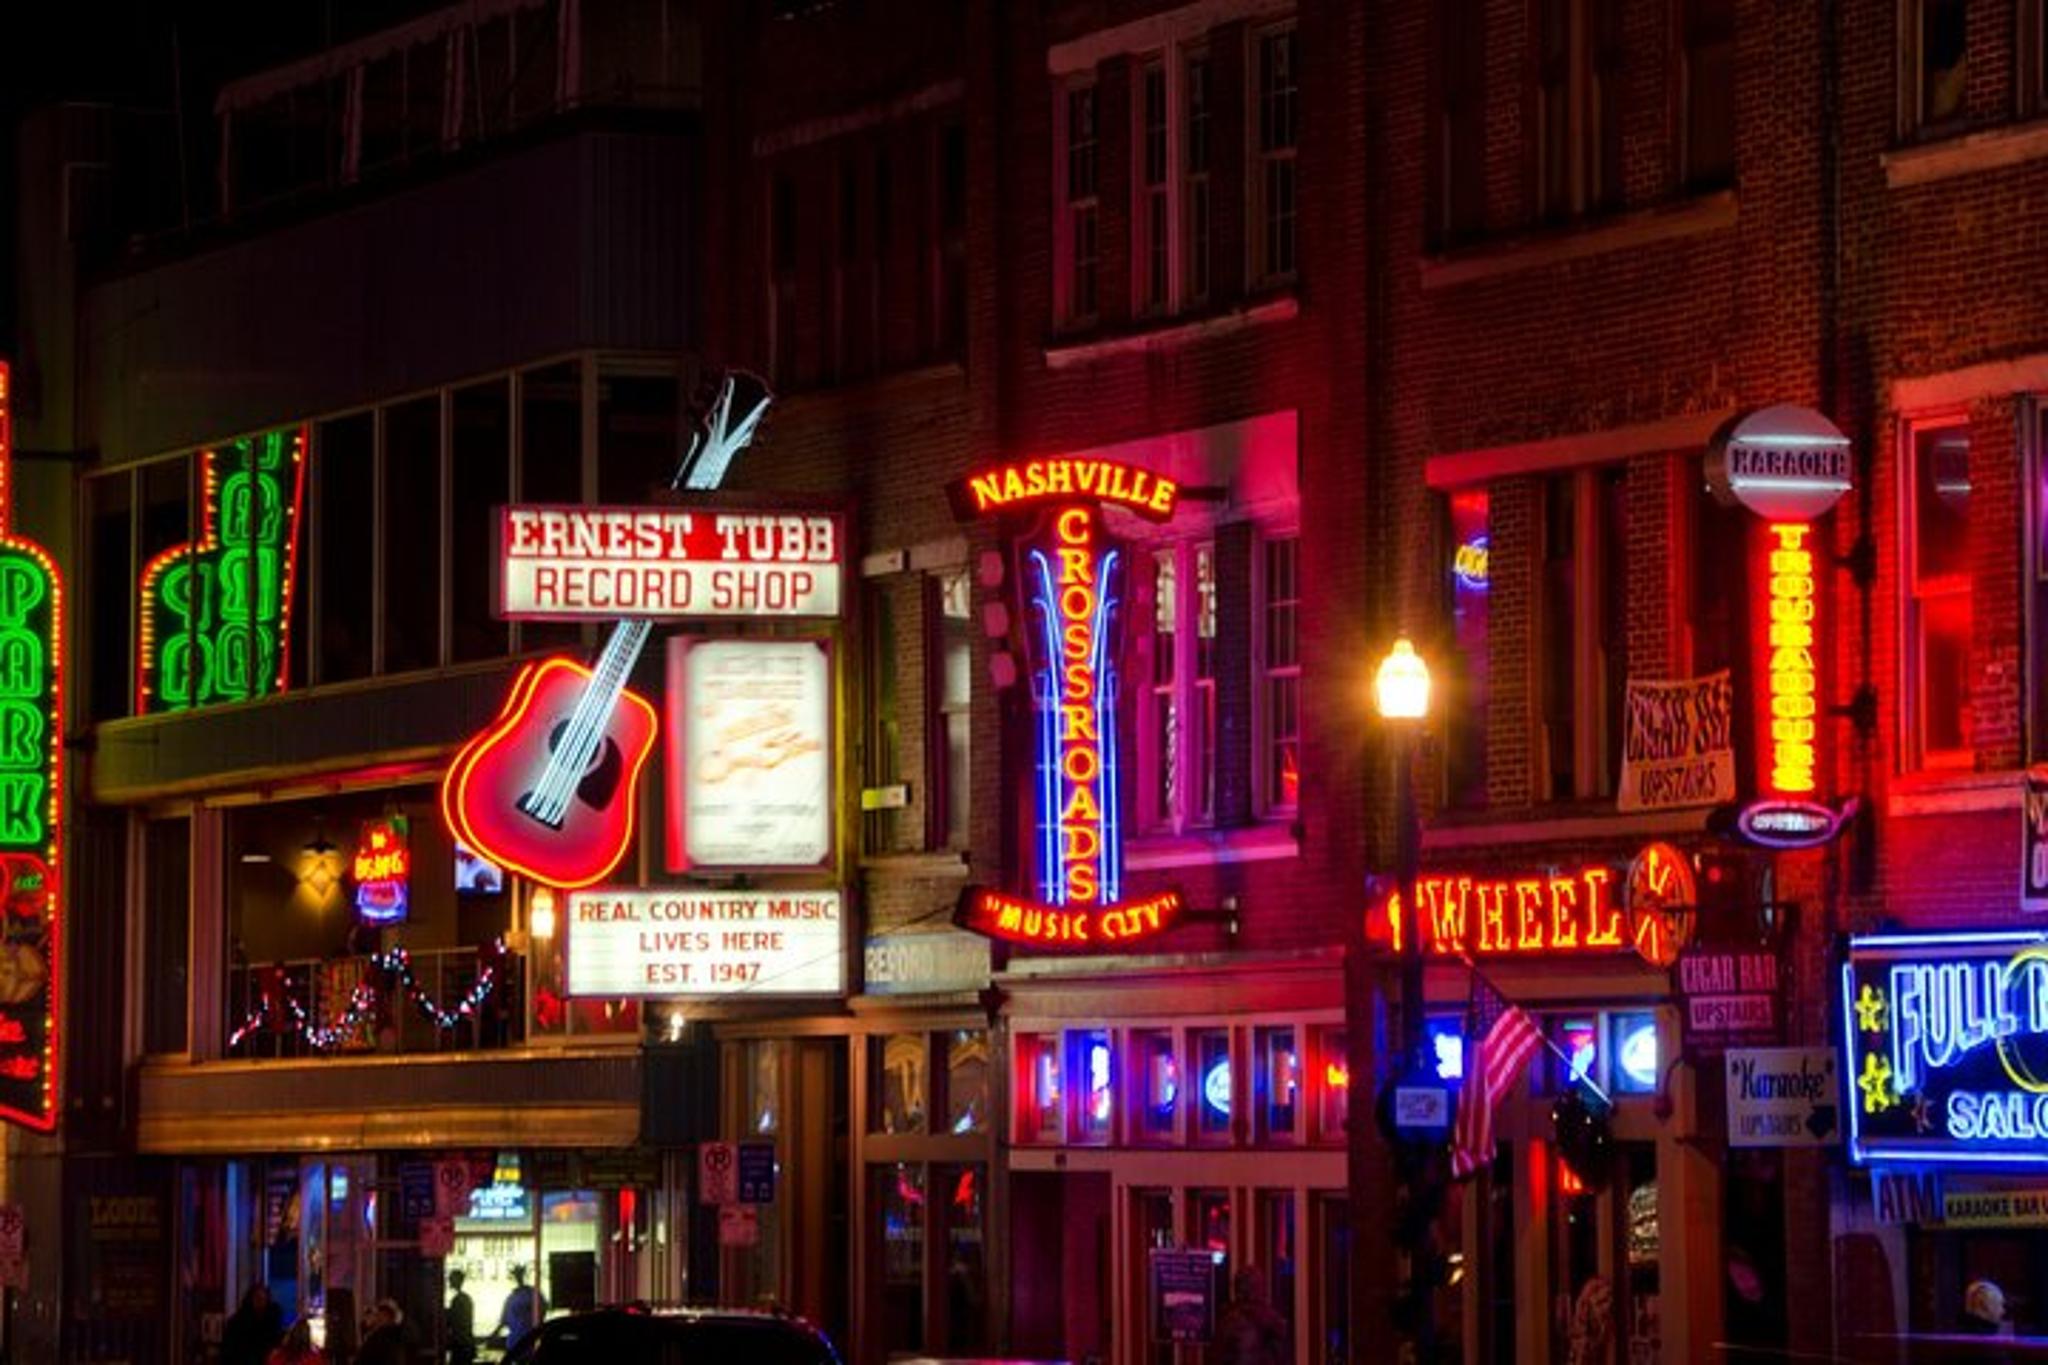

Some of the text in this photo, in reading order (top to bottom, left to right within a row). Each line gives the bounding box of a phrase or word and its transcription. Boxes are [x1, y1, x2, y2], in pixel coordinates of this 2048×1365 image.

[970, 460, 1176, 513] NASHVILLE
[508, 511, 836, 561] ERNEST TUBB
[533, 567, 814, 610] RECORD SHOP
[0, 555, 44, 845] PARK
[1057, 508, 1101, 901] CROSSROADS
[579, 900, 838, 921] REAL COUNTRY MUSIC
[638, 932, 785, 952] LIVES HERE
[646, 964, 763, 985] EST. 1947
[1680, 955, 1737, 993] CIGAR
[1890, 960, 2018, 1095] FULL
[1946, 1199, 2012, 1219] KARAOKE
